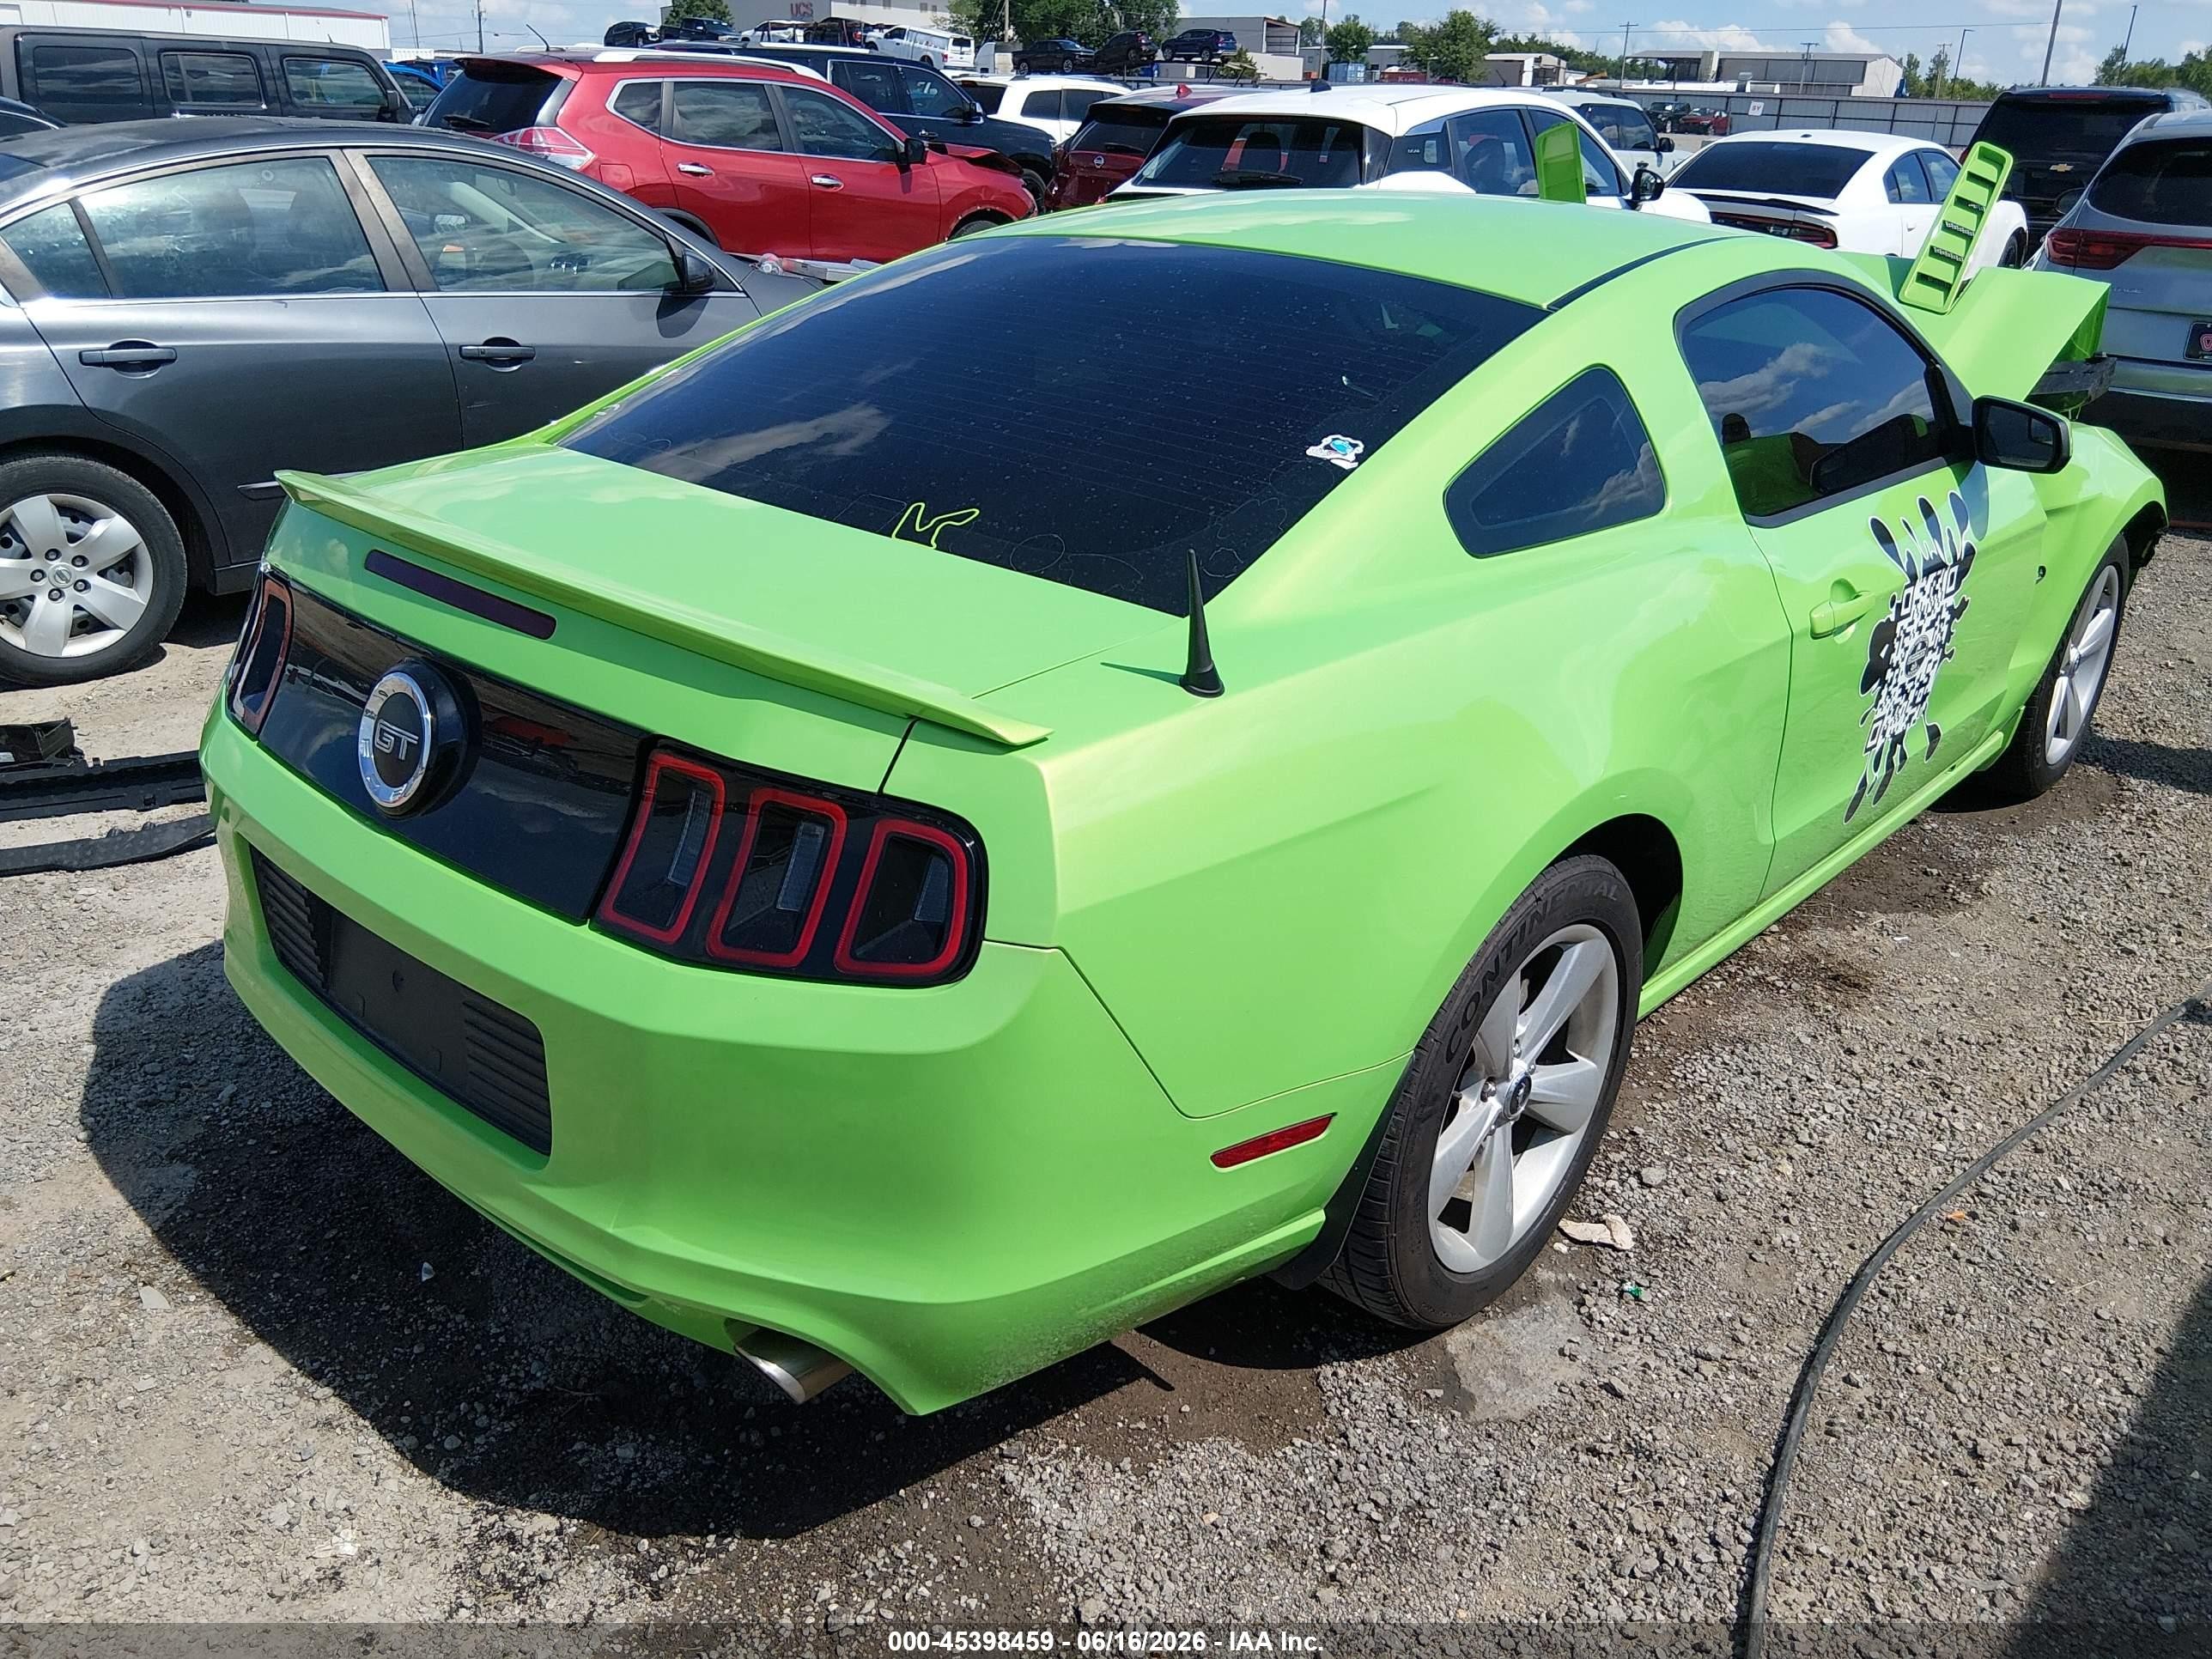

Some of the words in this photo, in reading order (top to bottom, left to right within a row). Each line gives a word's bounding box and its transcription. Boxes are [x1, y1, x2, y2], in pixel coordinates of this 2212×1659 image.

[790, 3, 814, 16] UCS
[374, 719, 419, 761] GT
[1445, 878, 1620, 1064] CONTINENTAL
